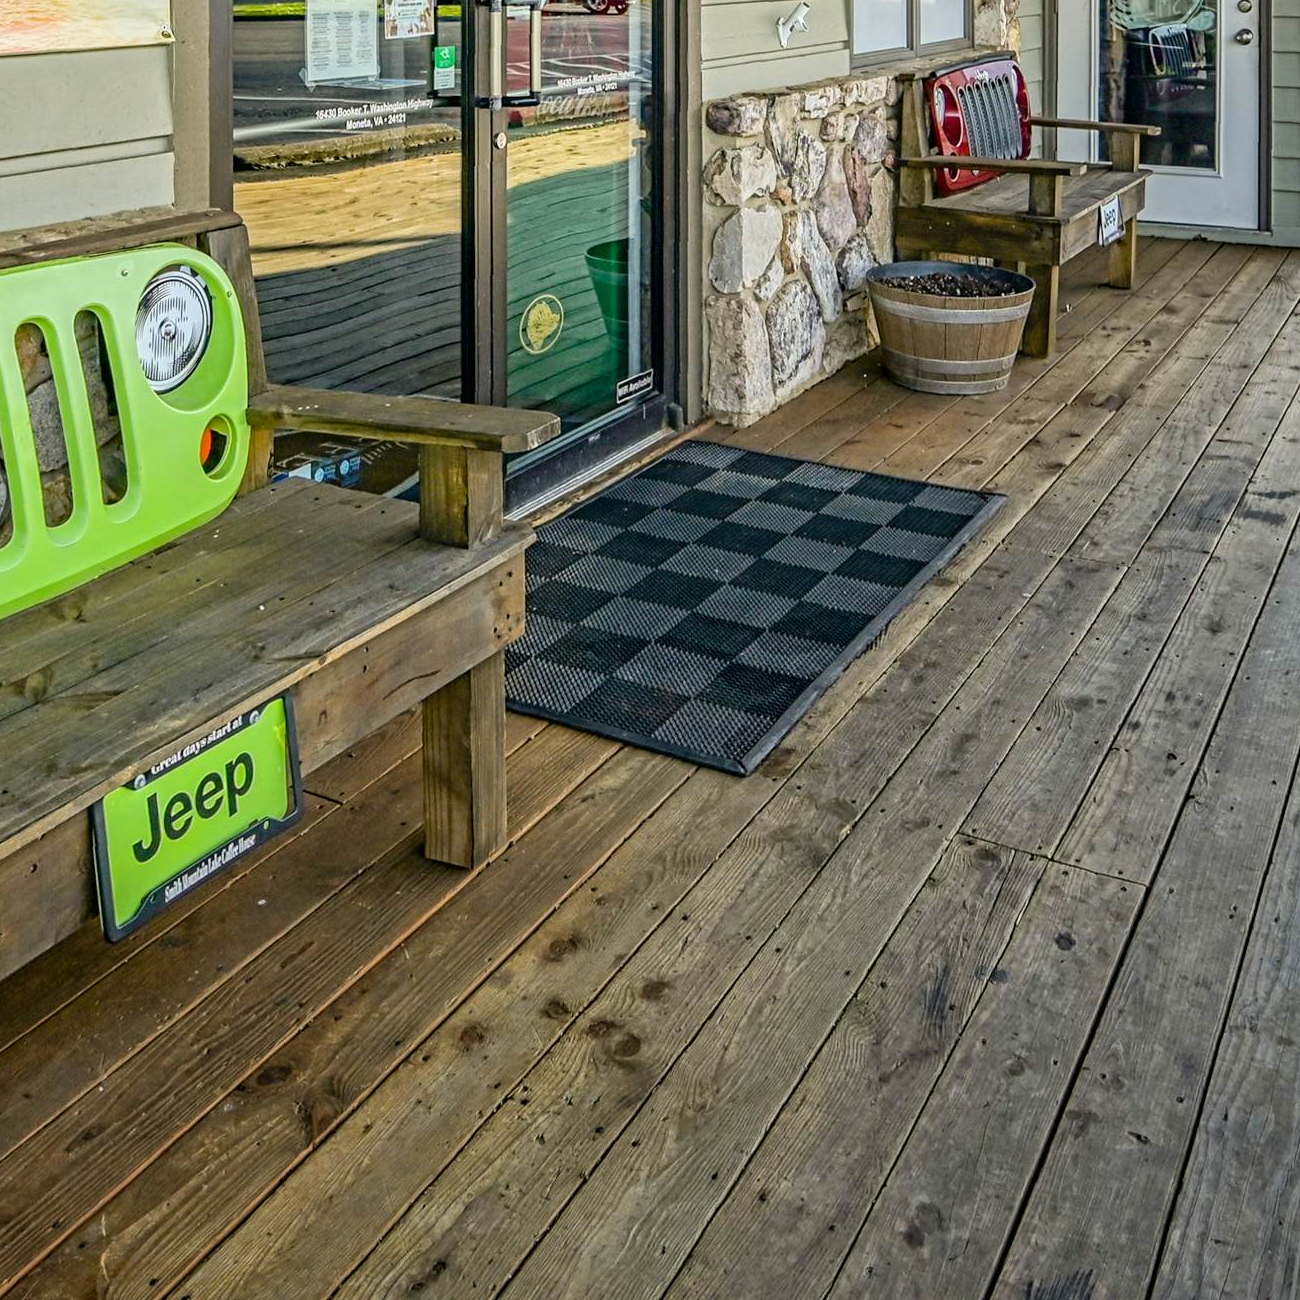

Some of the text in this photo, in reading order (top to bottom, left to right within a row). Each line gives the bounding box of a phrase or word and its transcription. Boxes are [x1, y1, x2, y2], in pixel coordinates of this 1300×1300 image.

[338, 105, 362, 117] Booker
[370, 100, 407, 114] Washington
[408, 98, 434, 110] Highway
[346, 113, 406, 131] Moneta, VA 24121
[183, 737, 206, 757] days
[207, 724, 232, 743] start
[232, 716, 243, 729] at
[132, 751, 255, 863] Jeep
[164, 834, 256, 903] Smith Mountain Lake Coffee House
